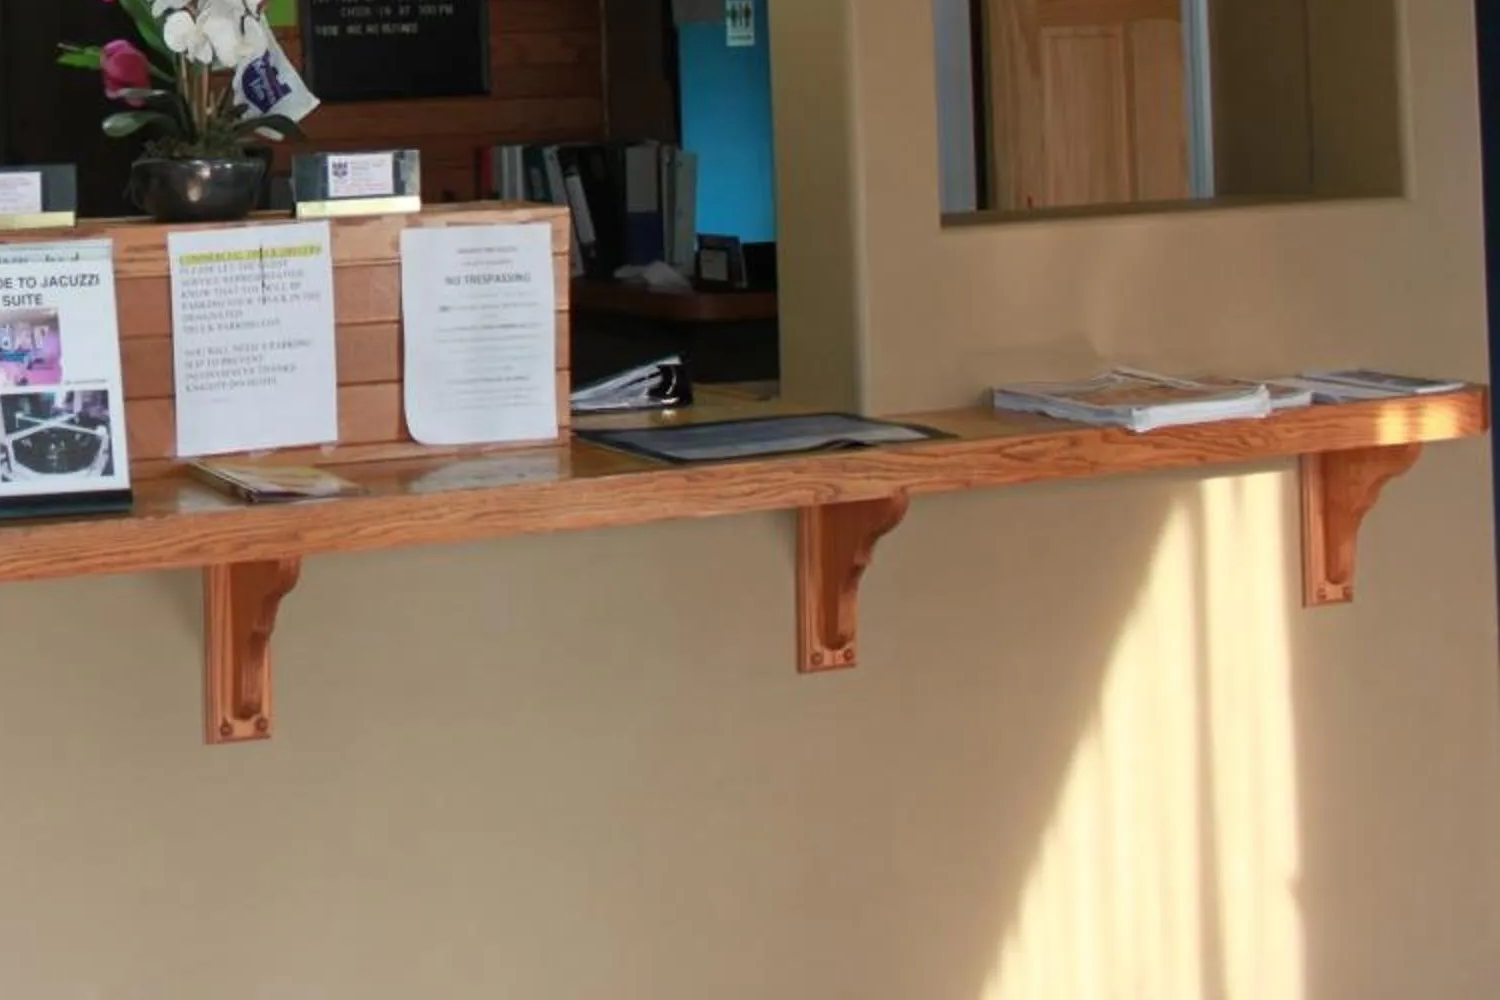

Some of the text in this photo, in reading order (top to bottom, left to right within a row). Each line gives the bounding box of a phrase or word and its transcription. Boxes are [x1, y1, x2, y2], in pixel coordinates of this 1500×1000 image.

[15, 275, 37, 290] TO
[39, 273, 100, 289] JACUZZI
[444, 272, 532, 286] NO TRESPASSING
[2, 293, 45, 308] SUITE
